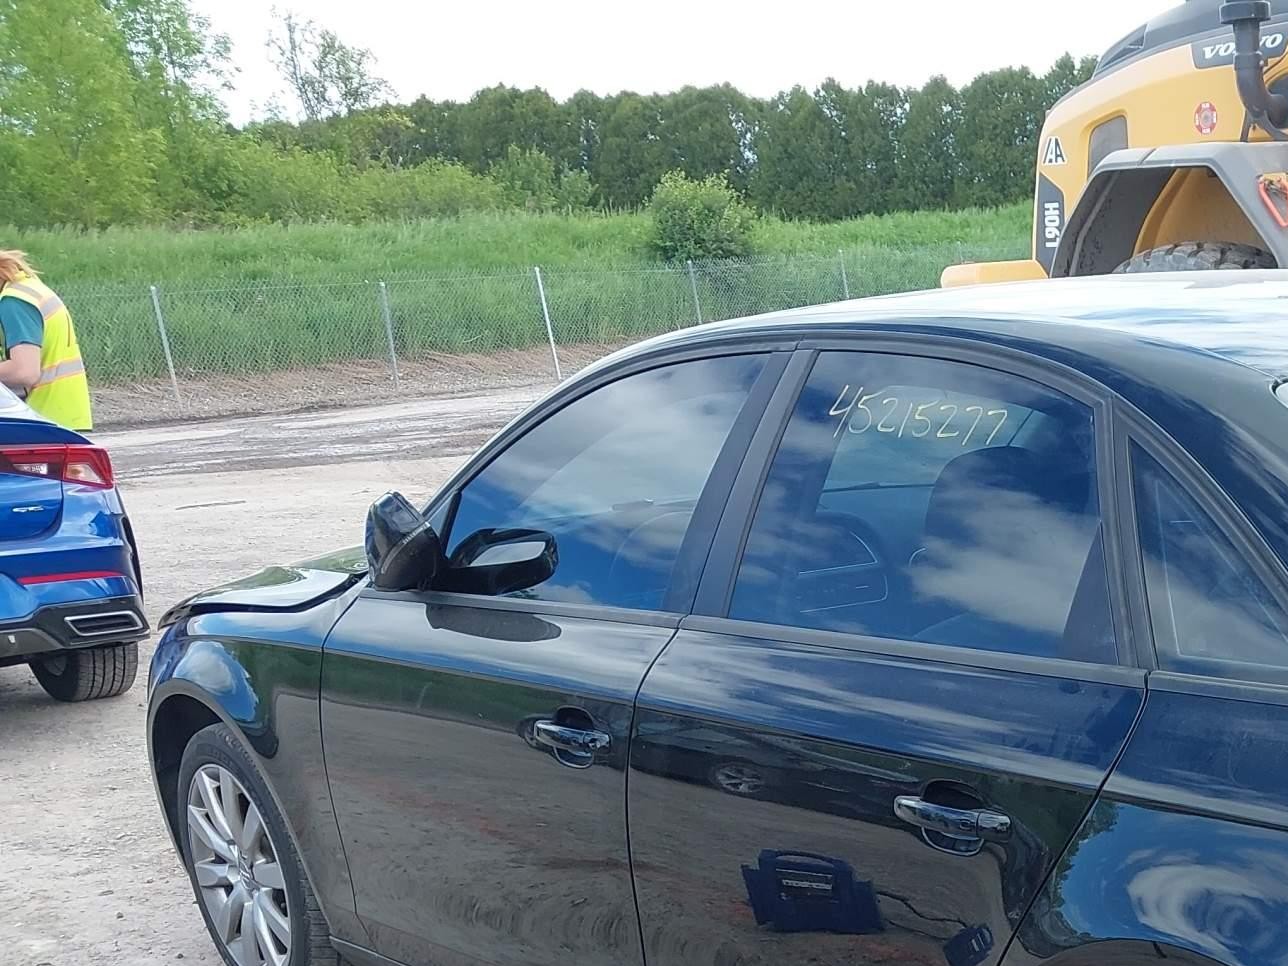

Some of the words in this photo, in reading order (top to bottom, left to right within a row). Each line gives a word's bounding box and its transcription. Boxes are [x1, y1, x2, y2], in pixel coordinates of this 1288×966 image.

[1203, 33, 1283, 59] VOO
[1043, 202, 1061, 248] L90H
[828, 384, 1008, 447] 45215277
